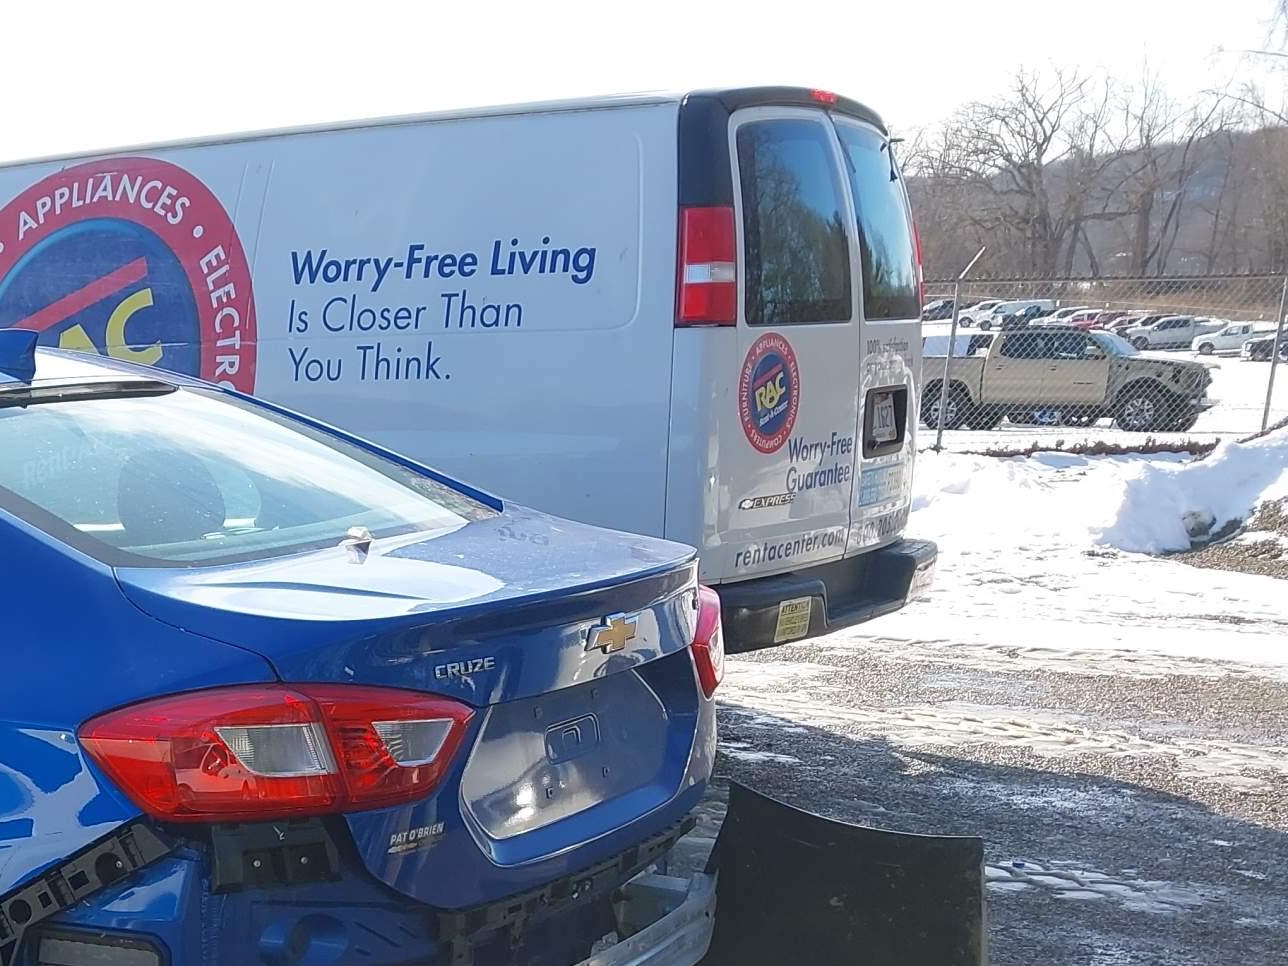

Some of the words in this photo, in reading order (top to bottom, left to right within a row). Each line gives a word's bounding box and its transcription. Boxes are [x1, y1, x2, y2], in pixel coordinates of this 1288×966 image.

[18, 173, 190, 241] APPLIANCES
[290, 243, 477, 292] Worry-Free
[490, 236, 597, 284] Living
[288, 299, 310, 333] Is
[322, 293, 427, 332] Closer
[440, 289, 523, 329] Than
[288, 347, 343, 382] You
[356, 341, 451, 381] Think.
[755, 338, 788, 356] APPLIANCES
[740, 361, 753, 422] FURNITURE
[755, 371, 786, 411] RAC
[786, 361, 799, 428] ELECTRONICS
[750, 429, 783, 449] COMPUTERS
[788, 432, 852, 466] Worry-Free
[786, 462, 850, 493] Guarantee
[735, 530, 845, 568] rentacenter.com
[435, 656, 496, 680] CRUZE
[390, 832, 408, 846] PAT
[409, 822, 445, 841] O'BRIEN
